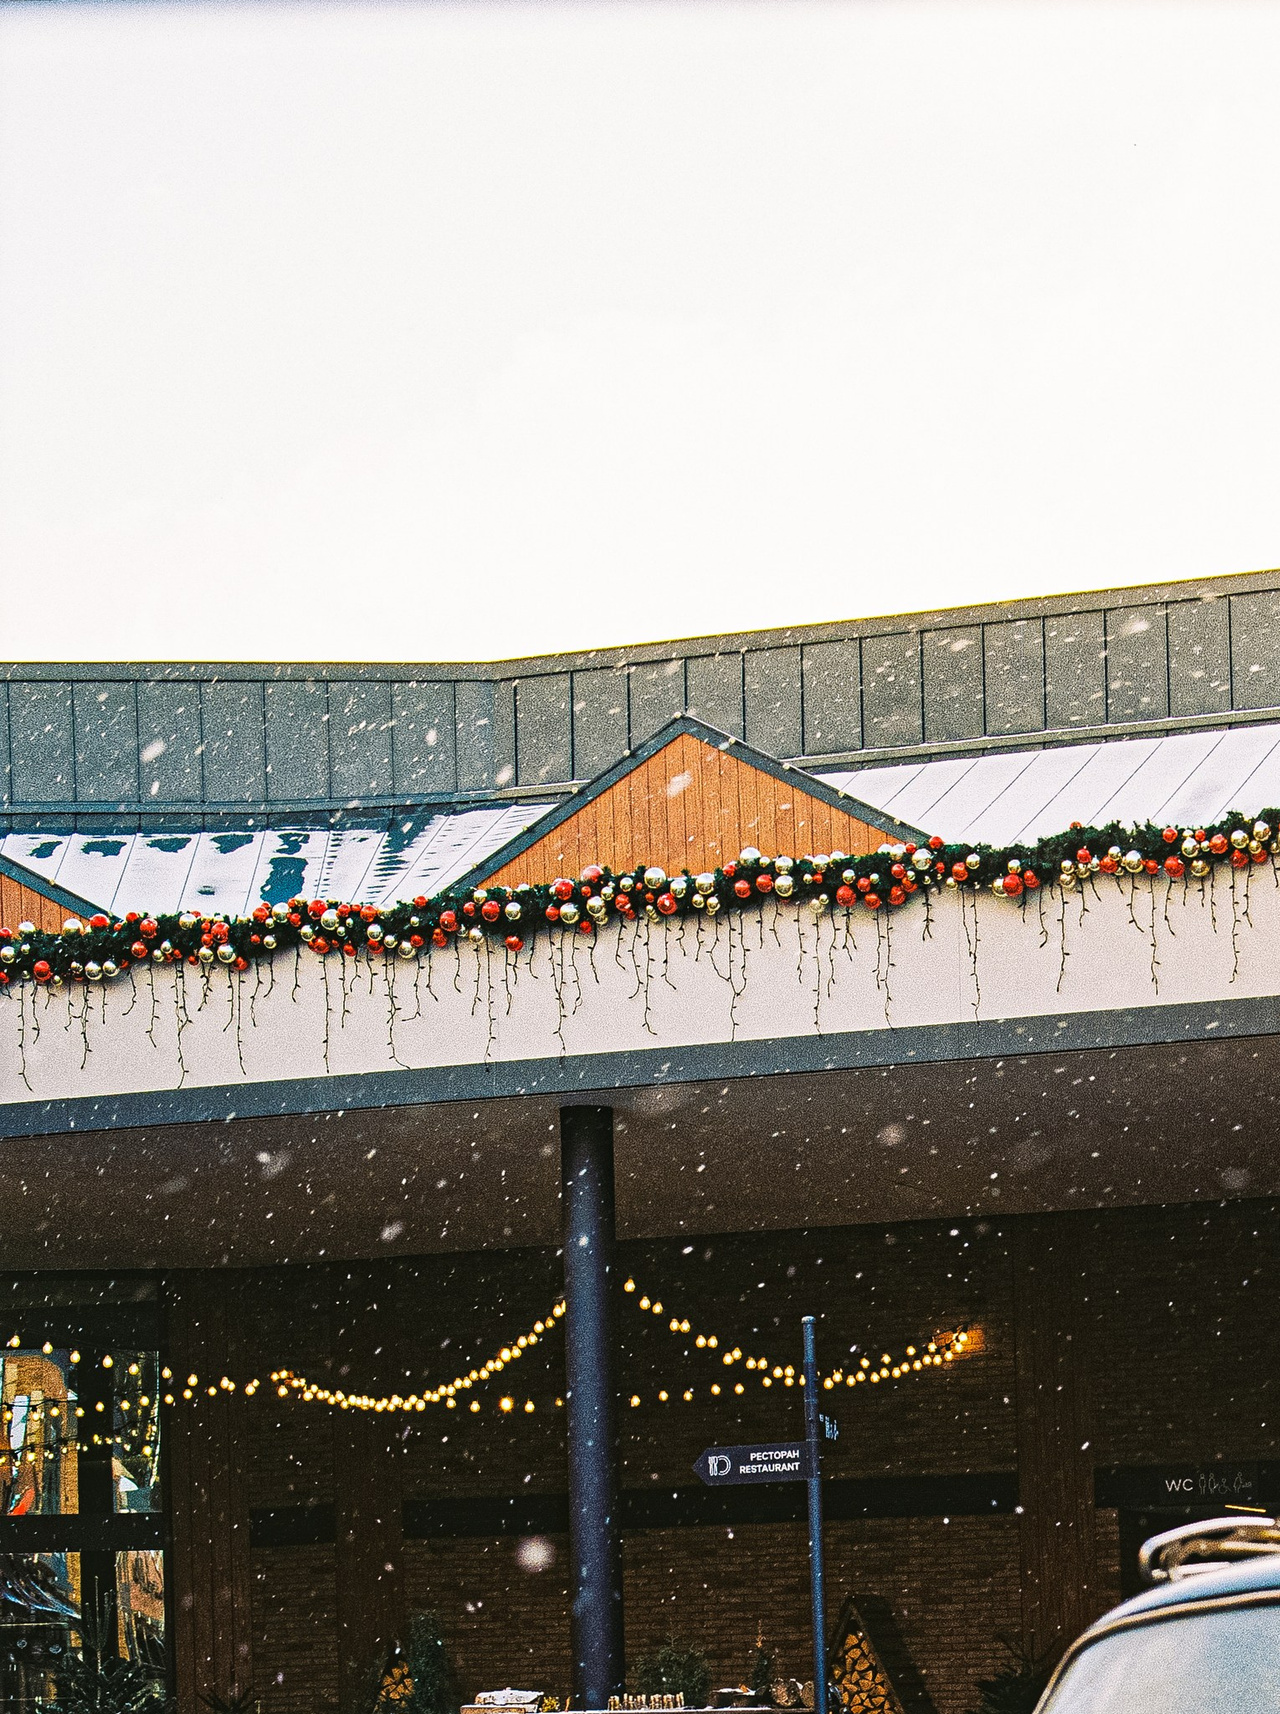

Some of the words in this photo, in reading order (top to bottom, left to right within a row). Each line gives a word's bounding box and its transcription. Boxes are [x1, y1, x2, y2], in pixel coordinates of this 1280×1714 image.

[750, 1449, 800, 1461] РЕСТОРАН
[739, 1461, 801, 1474] RESTAURANT
[1165, 1478, 1194, 1492] WC
